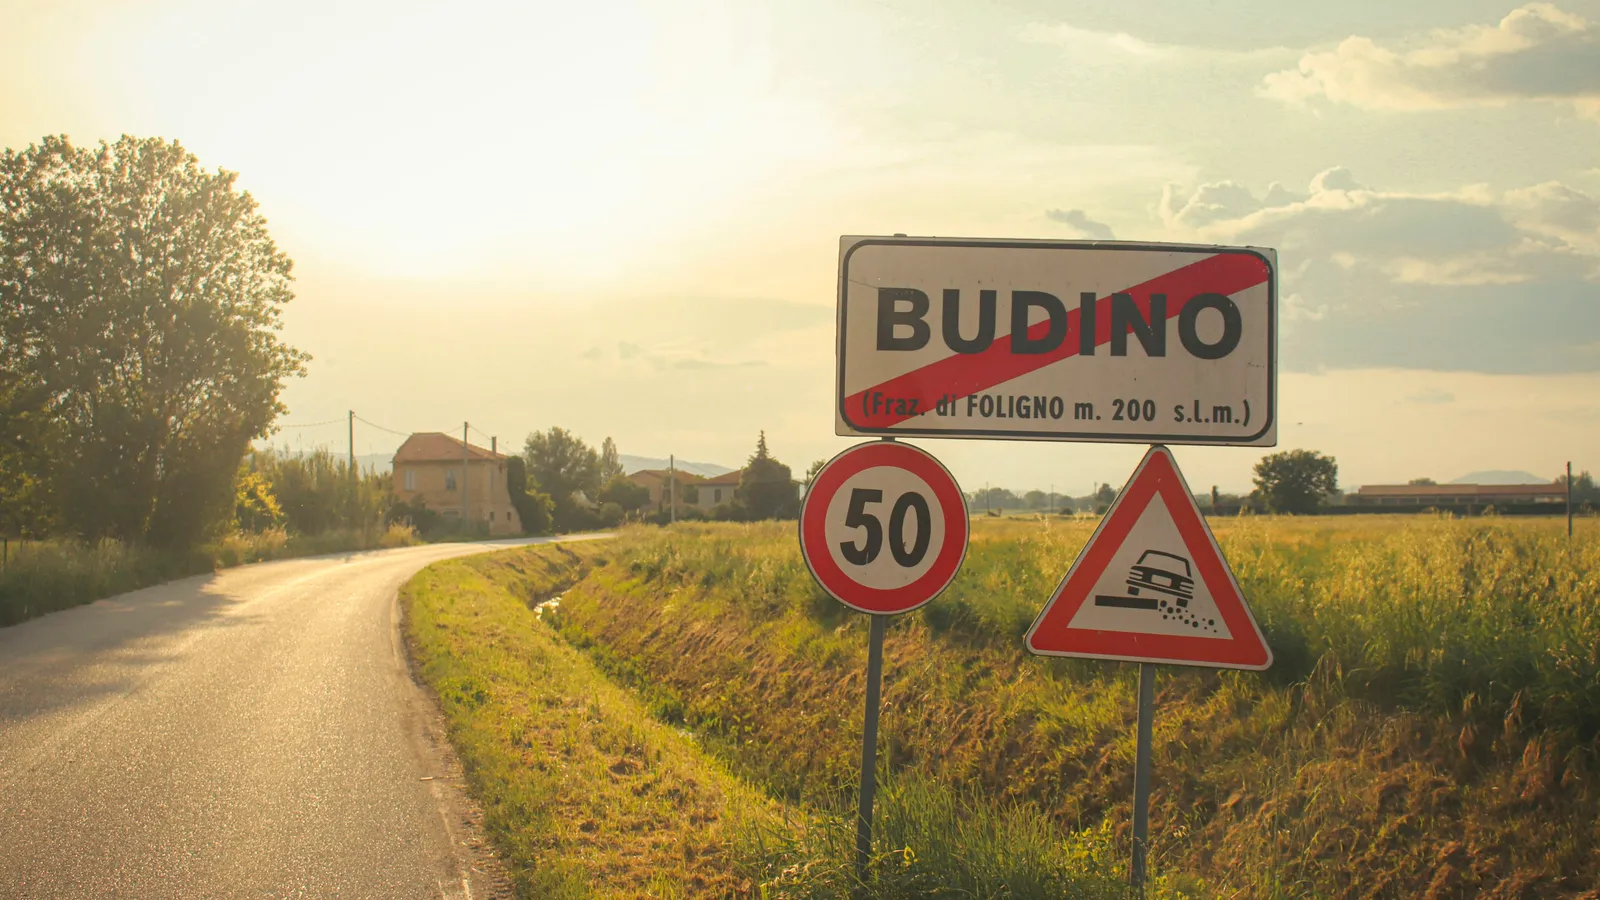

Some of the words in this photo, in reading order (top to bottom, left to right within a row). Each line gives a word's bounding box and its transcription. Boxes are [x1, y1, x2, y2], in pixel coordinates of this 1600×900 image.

[876, 287, 1242, 360] BUDINO
[862, 391, 925, 418] (Fraz.
[936, 393, 957, 417] di
[967, 394, 1064, 420] FOLIGNO
[1074, 401, 1101, 421] m.
[1112, 399, 1156, 422] 200
[1174, 400, 1251, 427] s.l.m.)
[839, 488, 932, 568] 50
